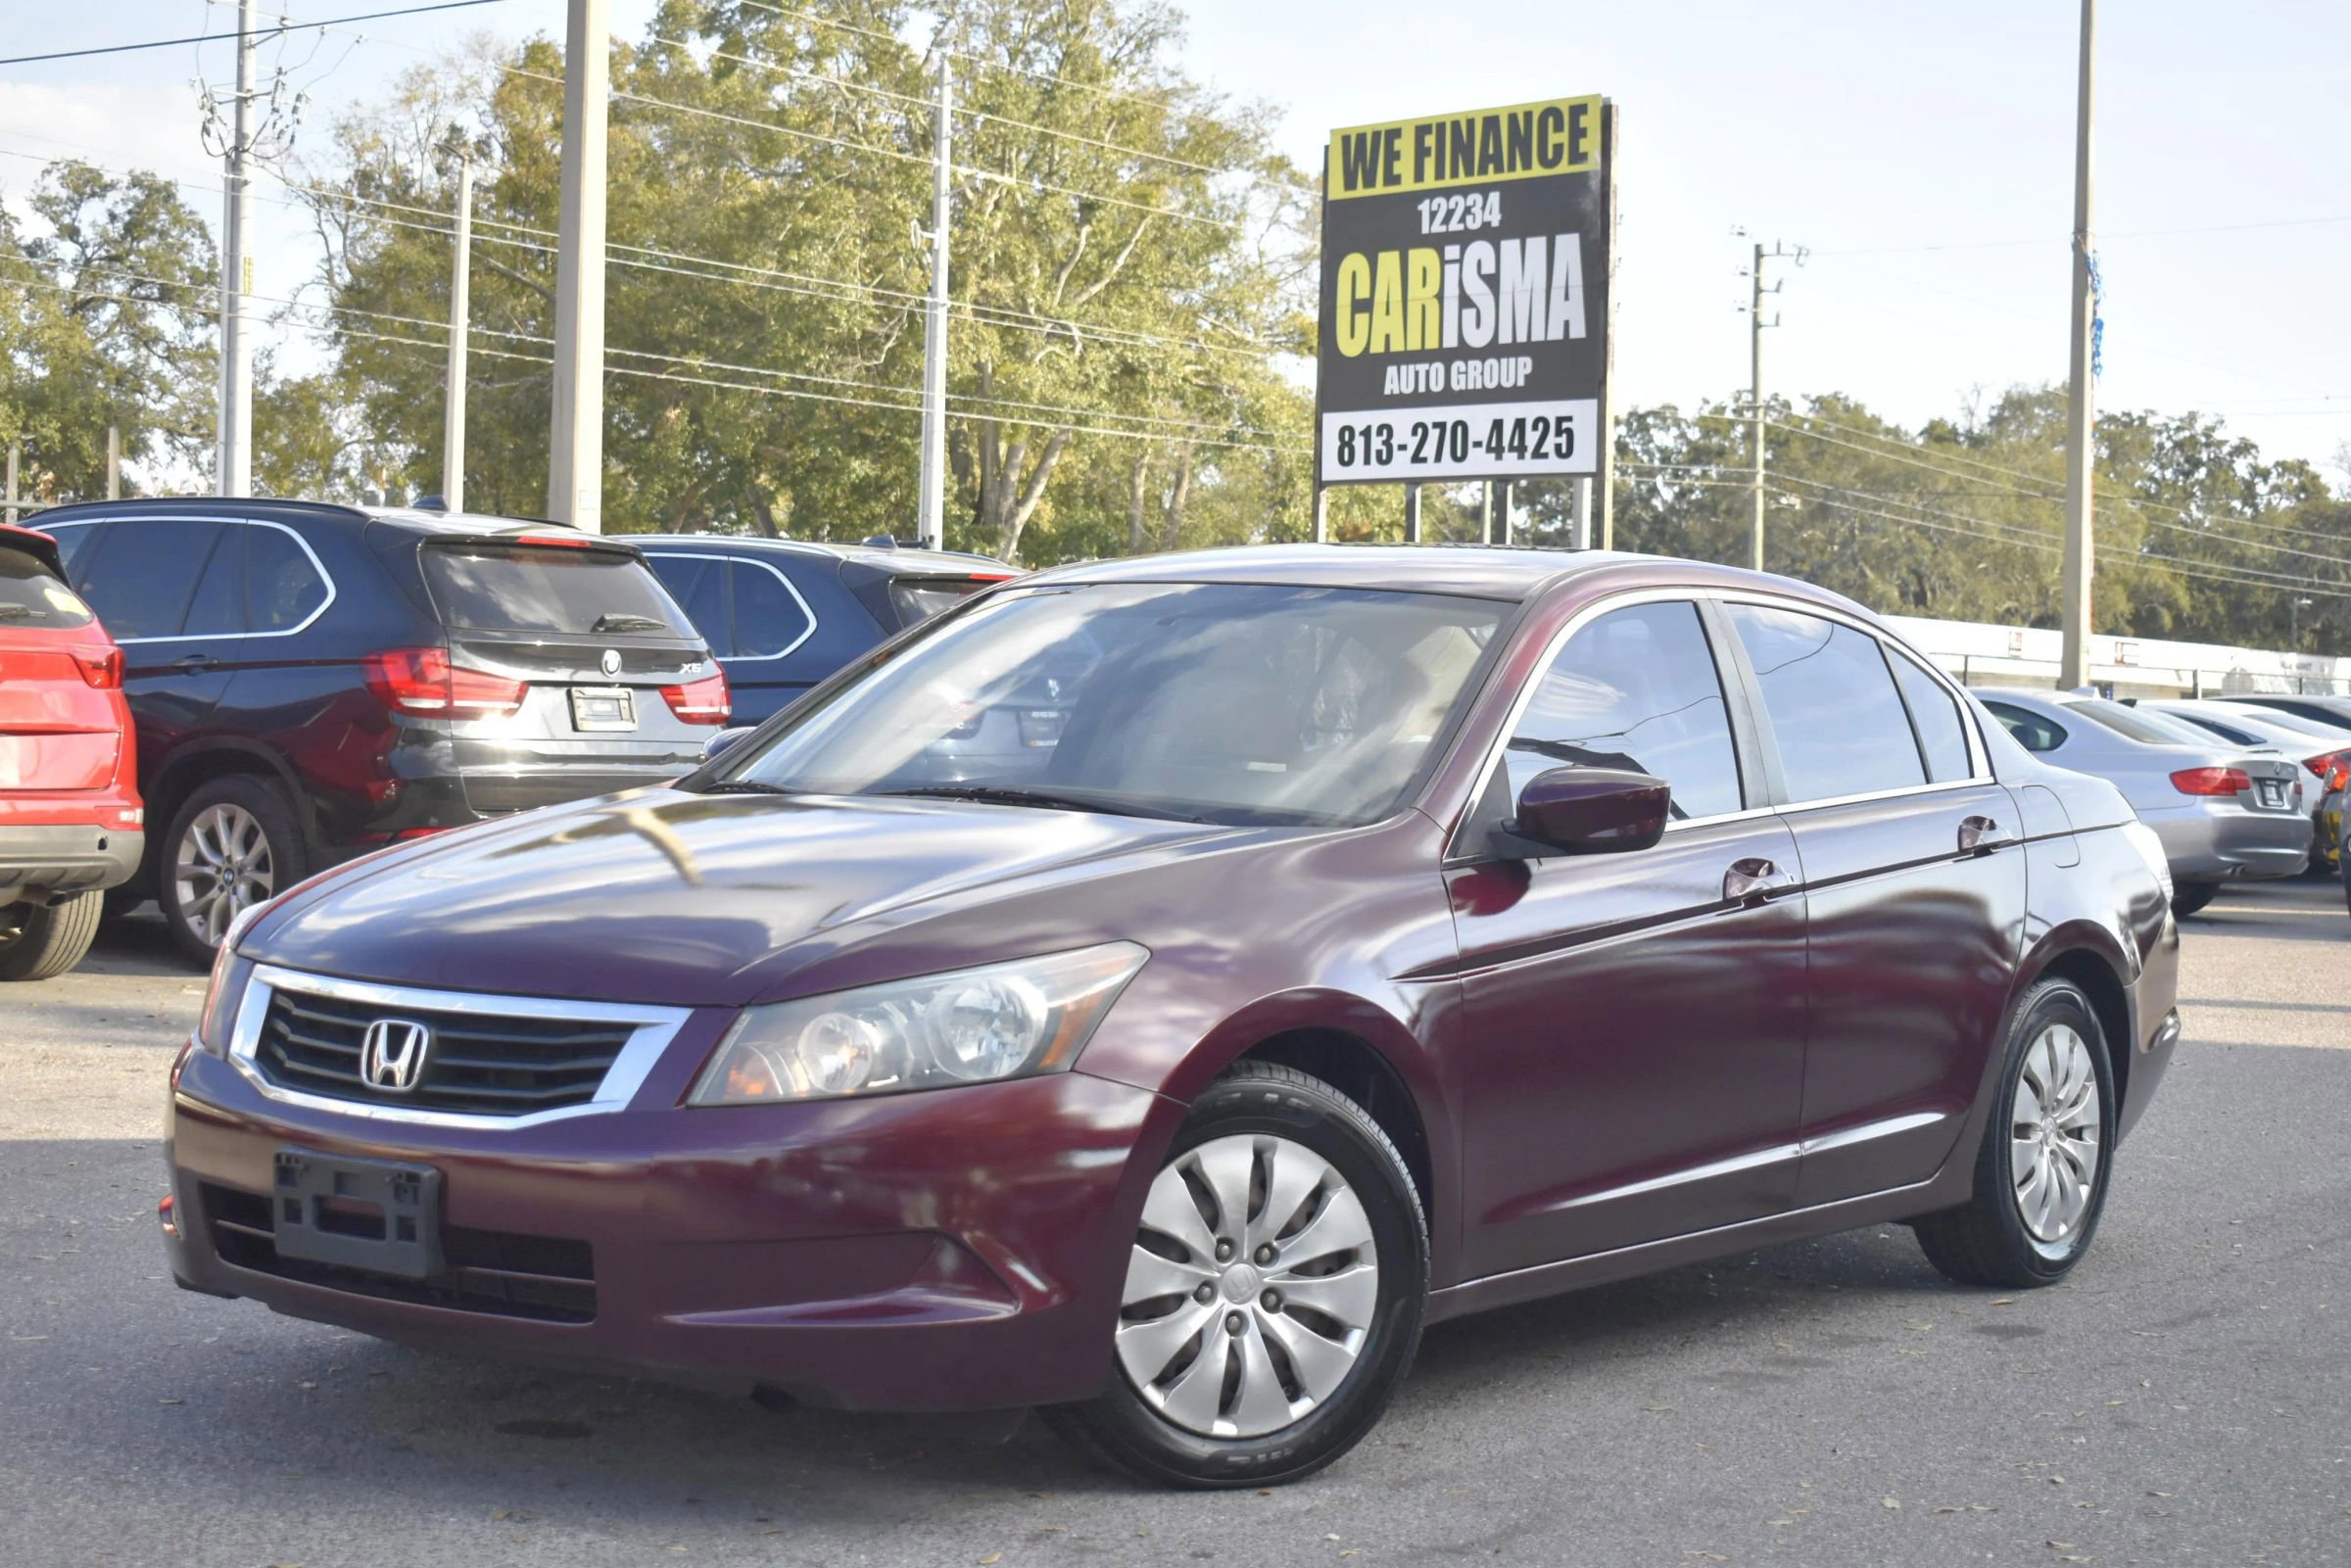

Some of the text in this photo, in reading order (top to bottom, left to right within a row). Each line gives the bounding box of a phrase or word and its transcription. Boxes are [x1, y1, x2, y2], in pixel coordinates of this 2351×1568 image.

[1341, 103, 1589, 191] WE FINANCE
[1417, 191, 1502, 234] 12234
[1335, 233, 1587, 357] CARiSMA
[1383, 356, 1533, 396] AUTO GROUP
[1337, 415, 1575, 467] 813-270-4425
